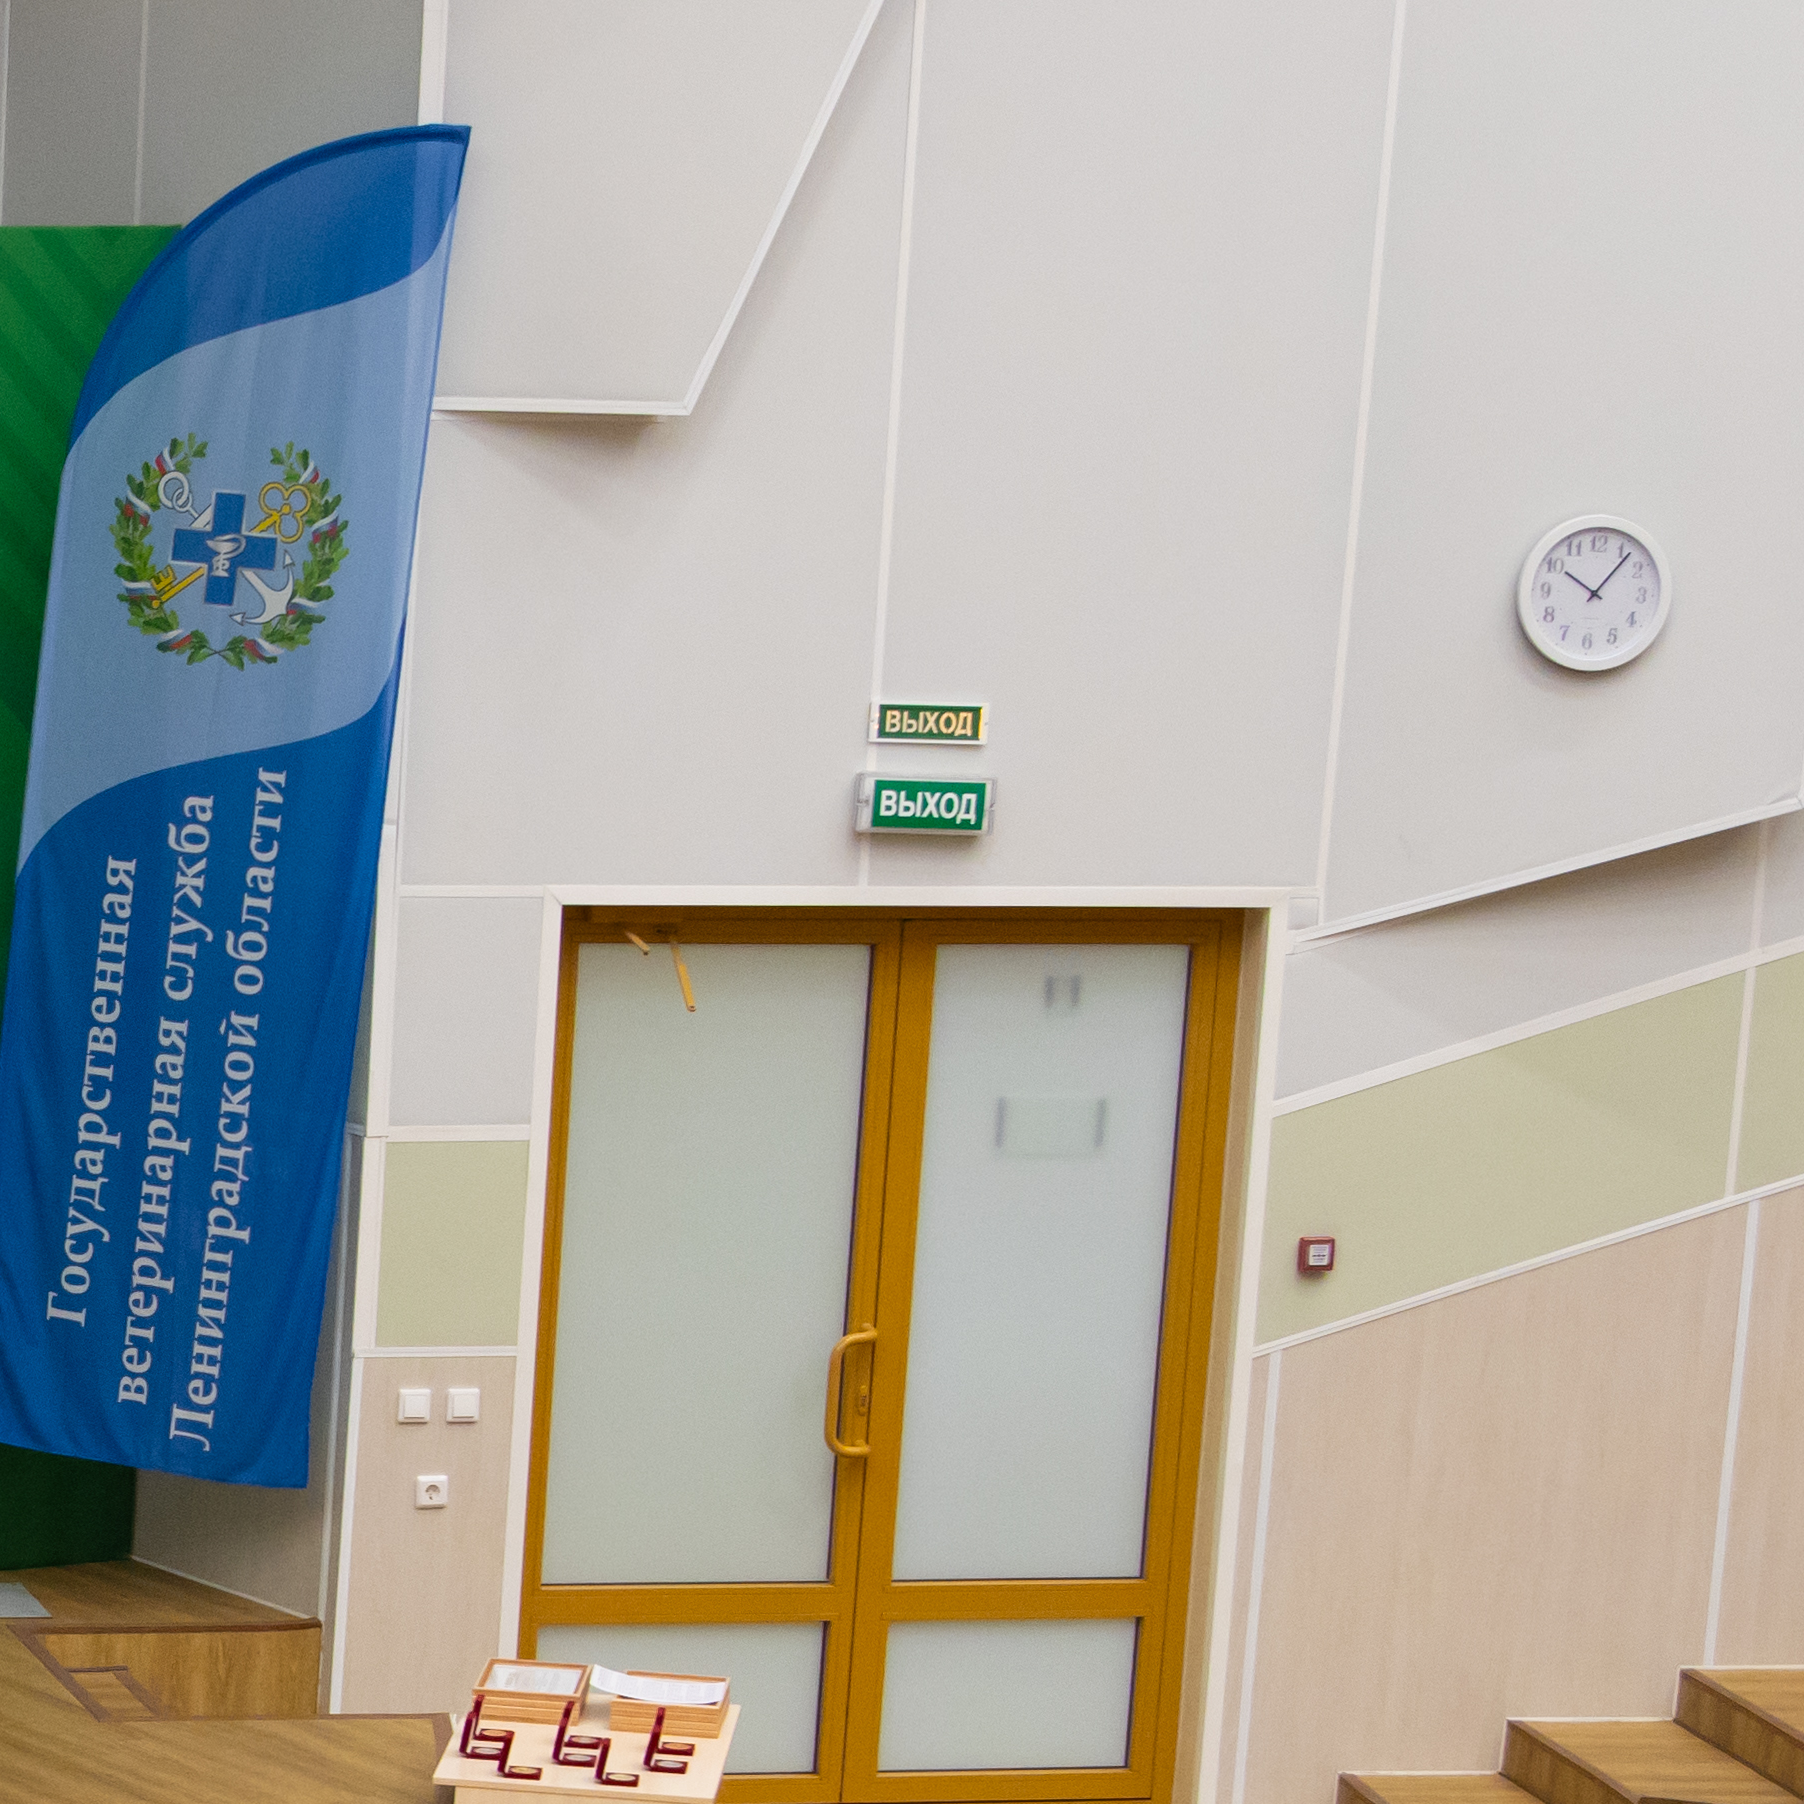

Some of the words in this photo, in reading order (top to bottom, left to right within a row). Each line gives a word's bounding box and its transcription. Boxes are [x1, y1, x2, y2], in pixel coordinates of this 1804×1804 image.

[1566, 540, 1582, 557] 11
[1589, 536, 1607, 553] 12
[1617, 542, 1624, 558] 1
[1546, 557, 1564, 574] 10
[1632, 561, 1643, 579] 2
[1540, 582, 1551, 599] 9
[1636, 587, 1647, 604] 3
[1543, 606, 1555, 623] 8
[1626, 611, 1637, 627] 4
[1560, 625, 1570, 641] 7
[1582, 633, 1593, 650] 6
[1607, 628, 1617, 645] 5
[885, 709, 973, 737] ВЫХОД
[879, 789, 978, 825] ВЫХОД
[46, 854, 137, 1328] Государственная
[118, 1015, 191, 1405] ветеринарная
[163, 794, 215, 1002] служба
[168, 1010, 260, 1452] Ленинградской
[225, 766, 288, 996] области
